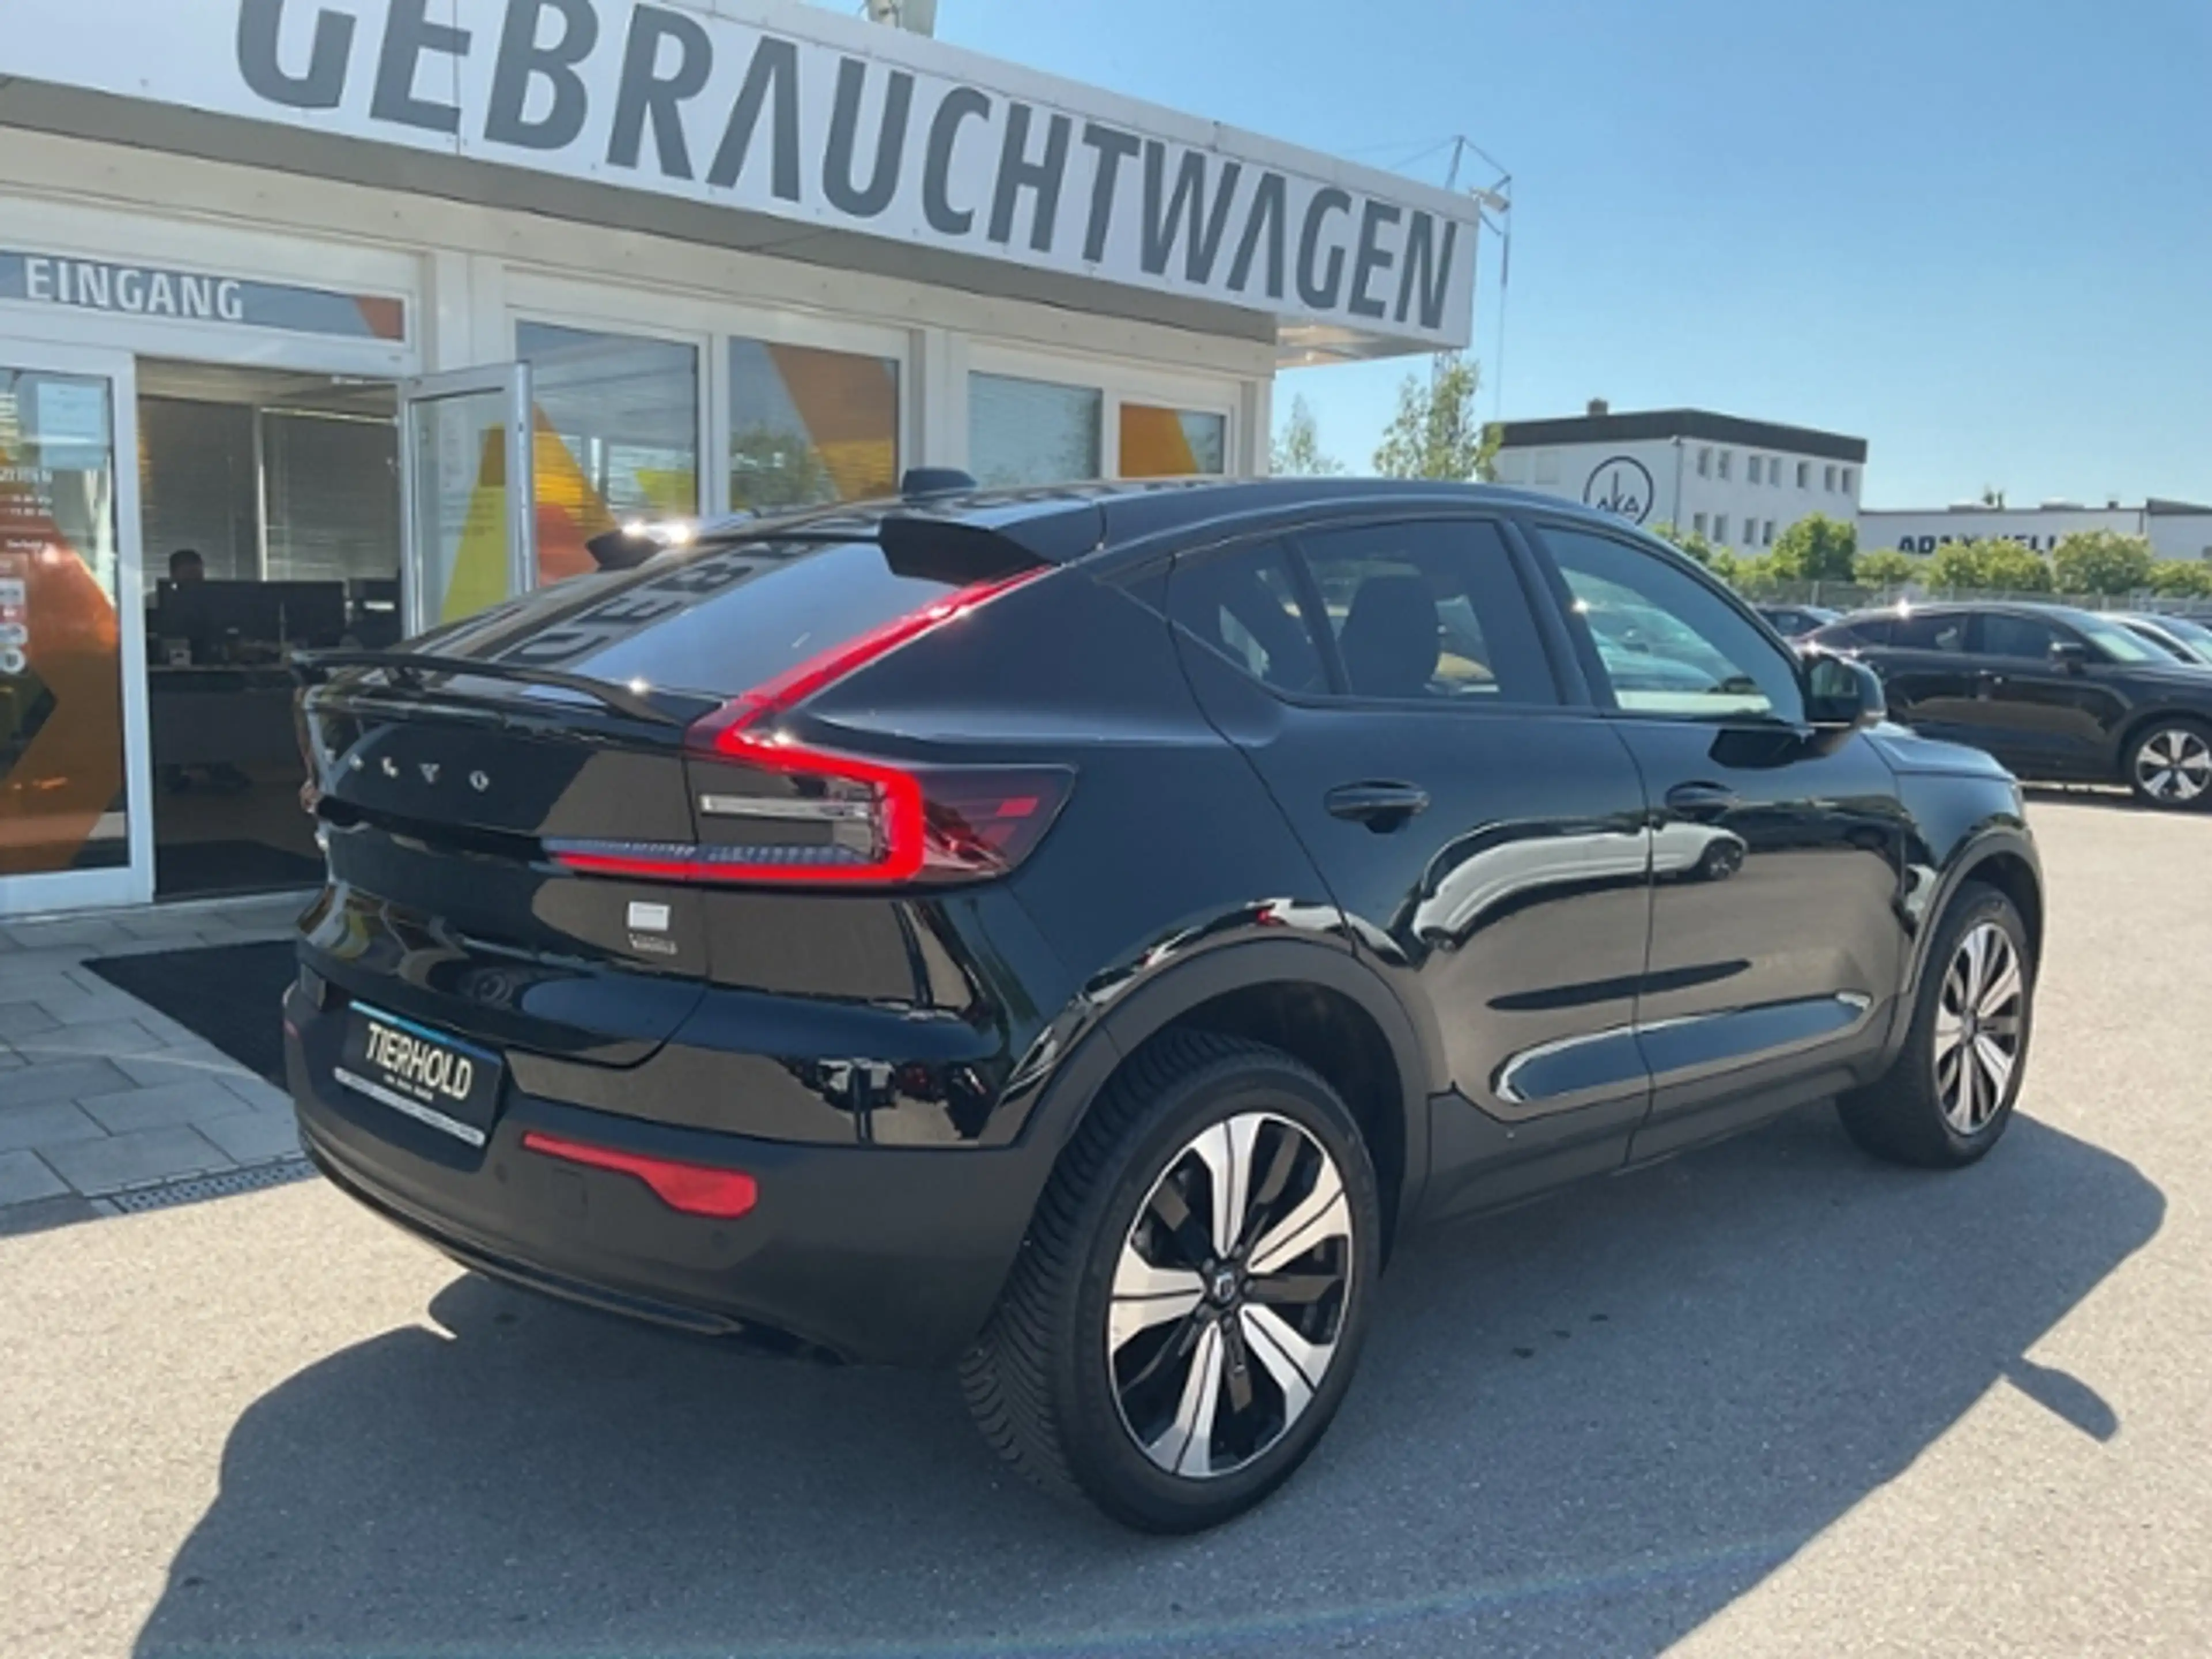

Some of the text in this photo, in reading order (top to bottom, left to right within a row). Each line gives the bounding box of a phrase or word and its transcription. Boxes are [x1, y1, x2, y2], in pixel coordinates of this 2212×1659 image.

[237, 0, 1457, 329] GEBRAUCHTWAGEN
[25, 257, 243, 320] EINGANG
[365, 1022, 472, 1101] TIERHOLD
